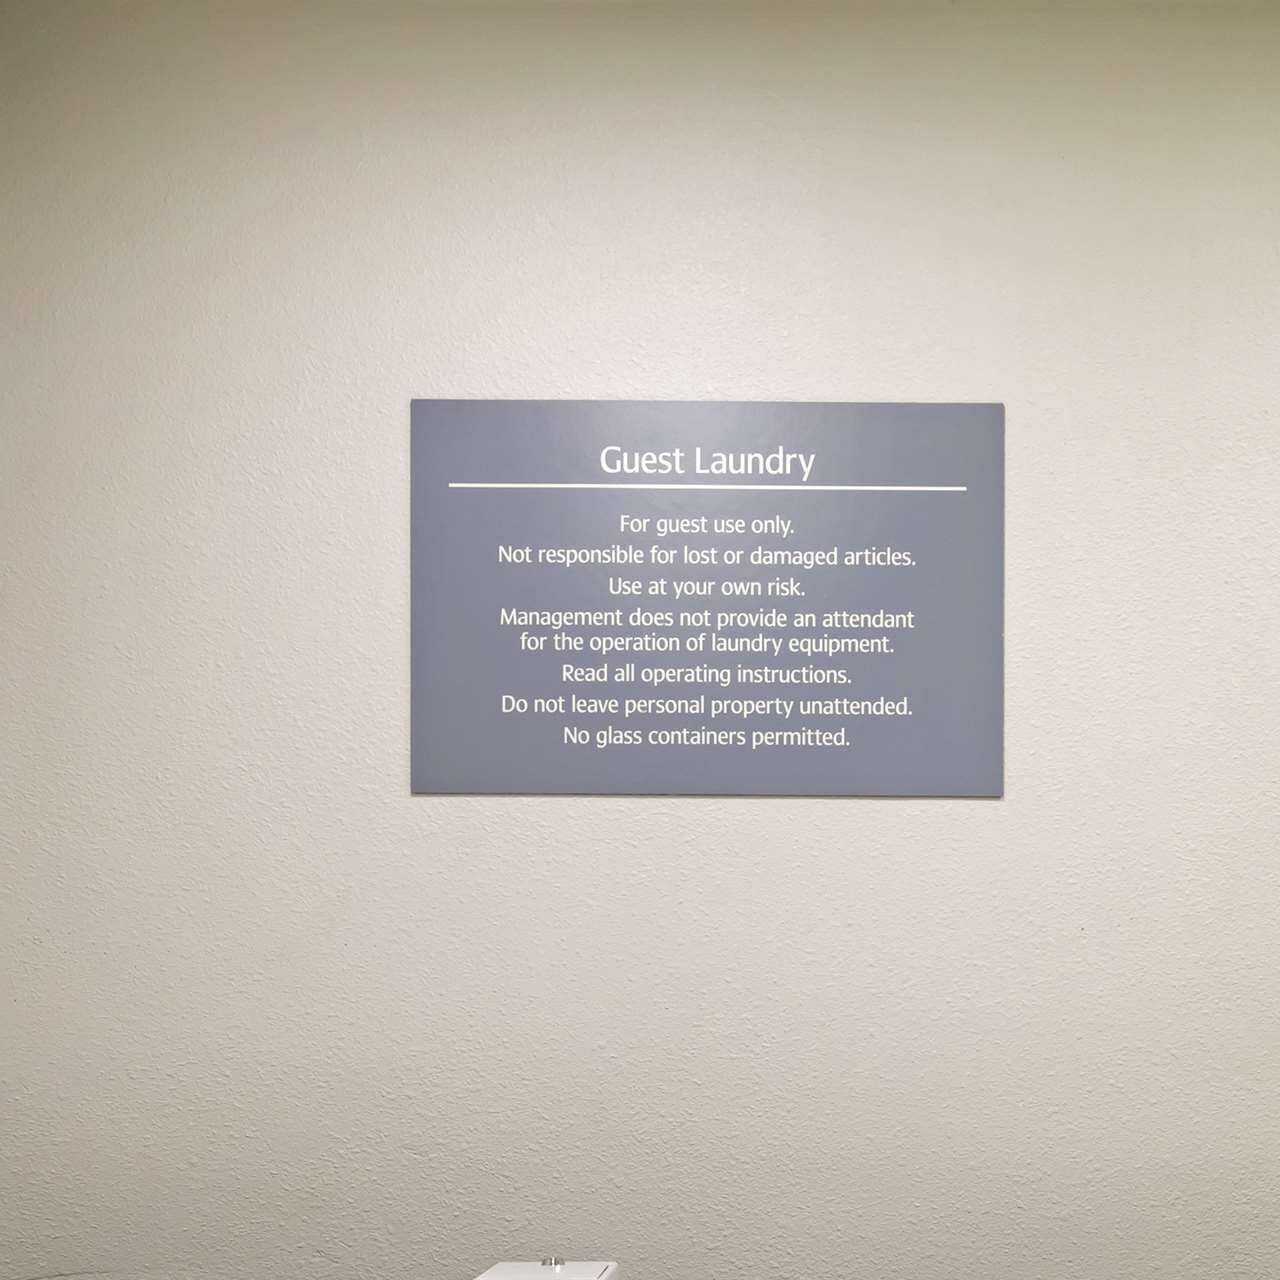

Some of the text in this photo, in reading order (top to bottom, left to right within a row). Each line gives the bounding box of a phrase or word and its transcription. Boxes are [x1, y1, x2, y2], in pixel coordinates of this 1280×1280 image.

[600, 445, 815, 482] Guest Laundry
[620, 514, 795, 538] For guest use only.
[498, 544, 916, 569] Not responsible for lost or damaged articles.
[609, 577, 805, 600] Use at your own risk.
[500, 607, 915, 631] Management does not provide an attendant
[519, 631, 894, 657] for the operation of laundry equipment.
[562, 663, 852, 687] Read all operating instructions.
[502, 694, 913, 719] Do not leave personal property unattended.
[563, 725, 850, 750] No glass containers permitted.
